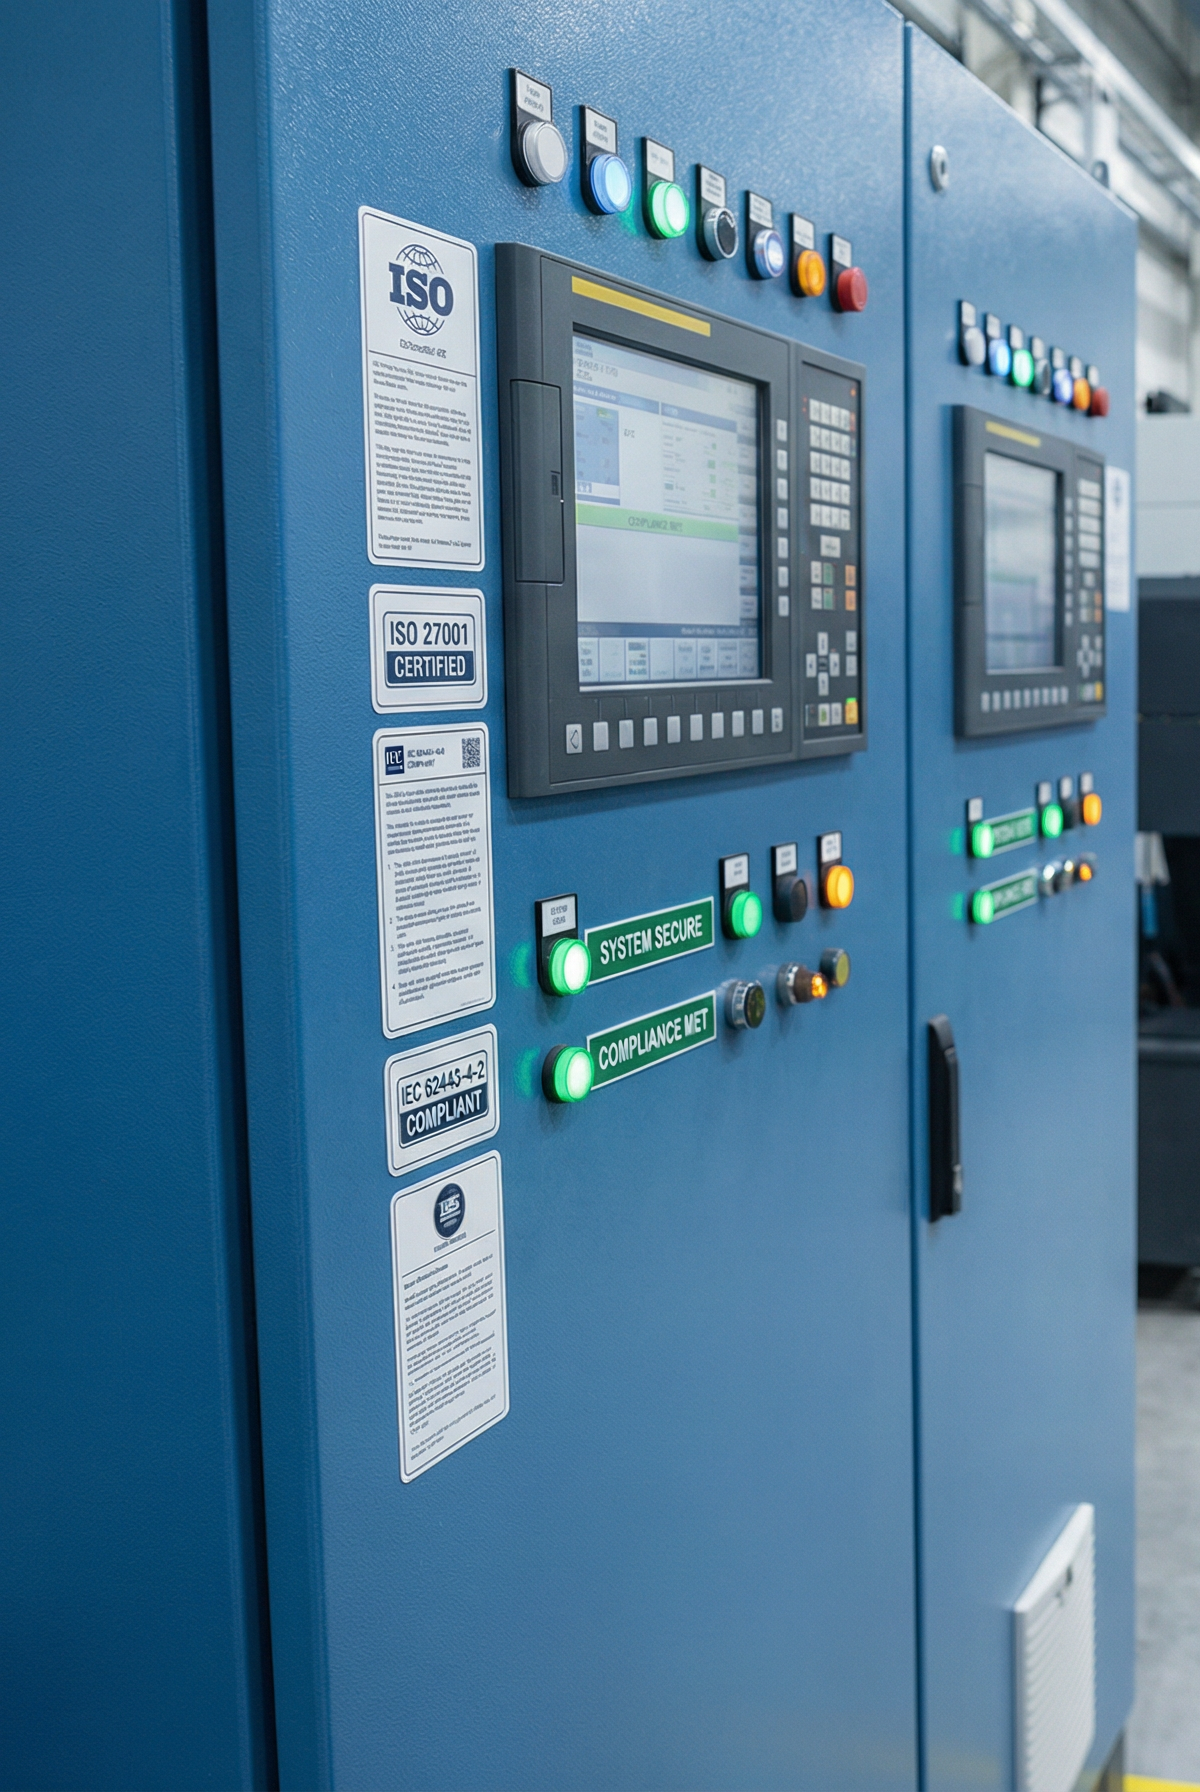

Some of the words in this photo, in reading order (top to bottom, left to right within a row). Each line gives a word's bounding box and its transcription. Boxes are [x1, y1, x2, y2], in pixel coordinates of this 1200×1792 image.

[388, 261, 454, 317] ISO
[390, 620, 418, 646] ISO
[423, 621, 468, 646] 27001
[394, 655, 466, 678] CERTIFIED
[600, 927, 652, 965] SYSTEM
[654, 914, 703, 949] SECURE
[598, 1016, 682, 1070] COMPLIANCE
[684, 1007, 709, 1037] MET
[401, 1081, 422, 1106] IEC
[406, 1089, 483, 1137] COMPLIANT
